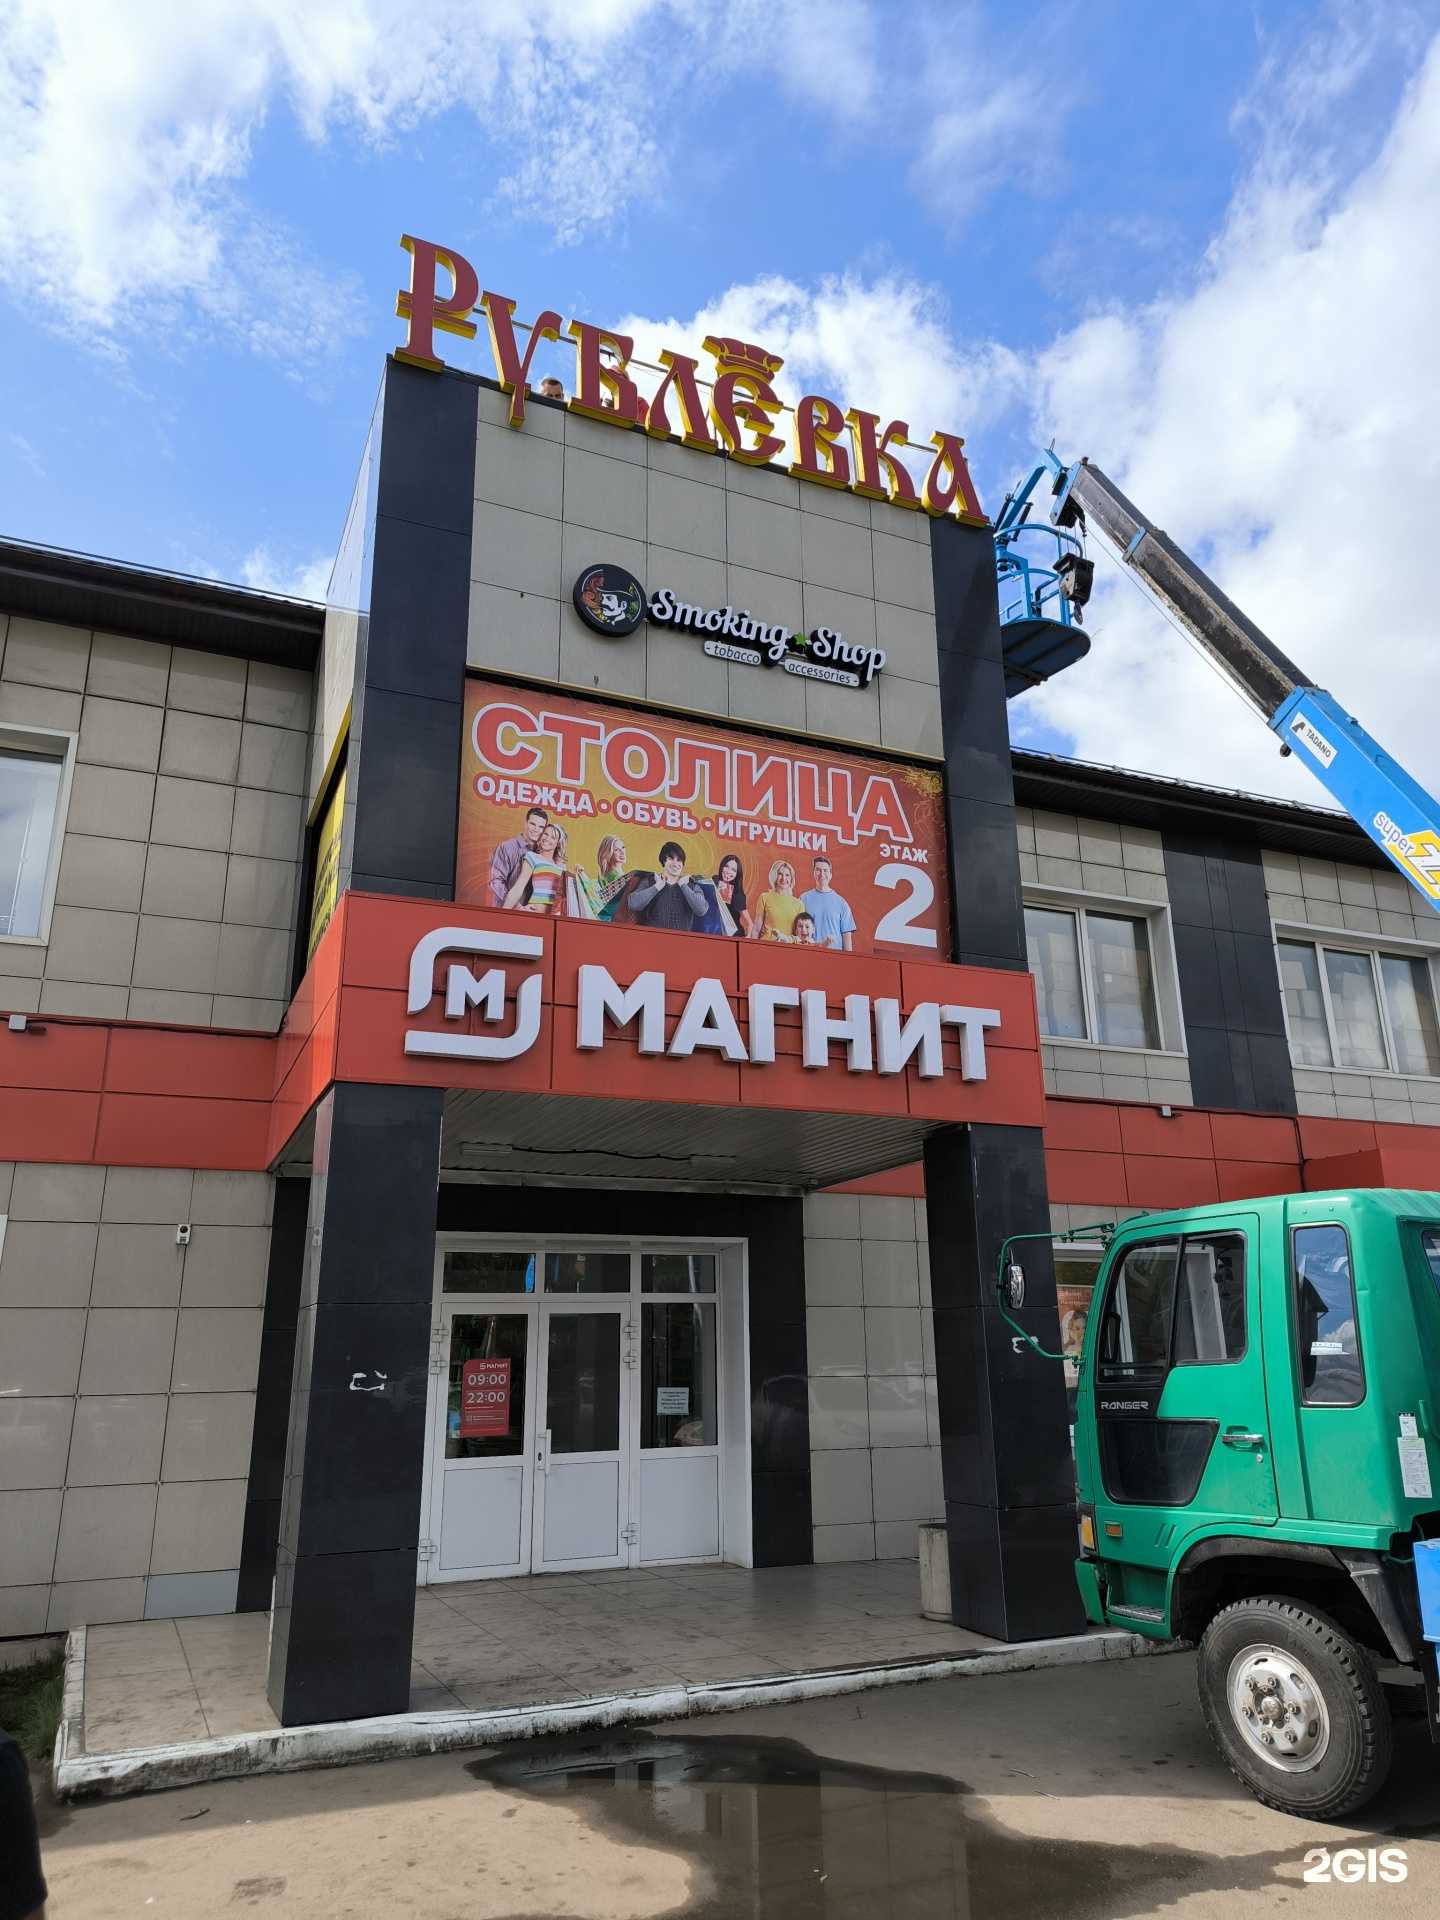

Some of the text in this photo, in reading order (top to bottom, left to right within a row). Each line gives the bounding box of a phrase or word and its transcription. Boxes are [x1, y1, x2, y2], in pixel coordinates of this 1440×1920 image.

[648, 588, 887, 682] Smoking Shop
[1306, 729, 1332, 758] TADANO
[471, 702, 914, 846] СТОЛИЦА
[476, 776, 828, 853] ОДЕЖДА ОБУВЬ ИГРУШКИ
[1374, 812, 1416, 856] super
[879, 843, 928, 864] ЭТАЖ
[873, 863, 938, 949] 2
[577, 964, 1001, 1082] МАГНИТ
[466, 1391, 506, 1404] 22:00
[468, 1374, 507, 1386] 09:00
[1100, 1401, 1149, 1410] RANGER
